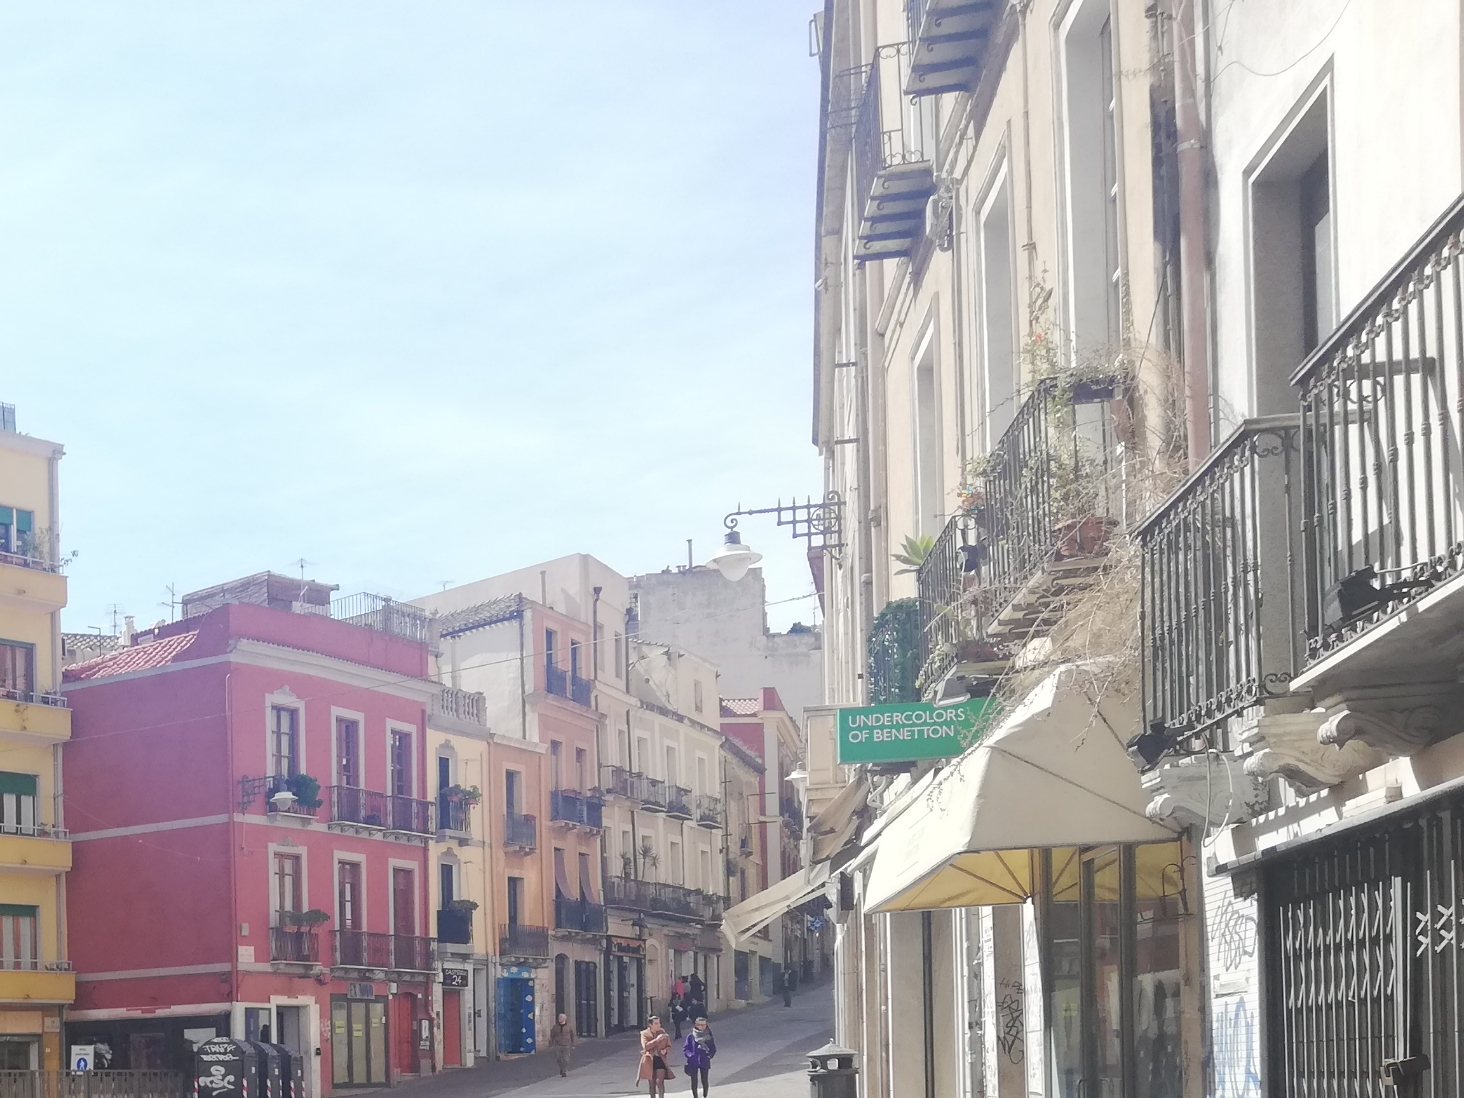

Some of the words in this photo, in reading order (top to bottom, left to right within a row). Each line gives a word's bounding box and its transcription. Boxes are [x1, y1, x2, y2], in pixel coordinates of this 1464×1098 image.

[848, 708, 965, 728] UNDERCOLORS
[848, 730, 870, 743] OF
[873, 725, 955, 742] BENETTON
